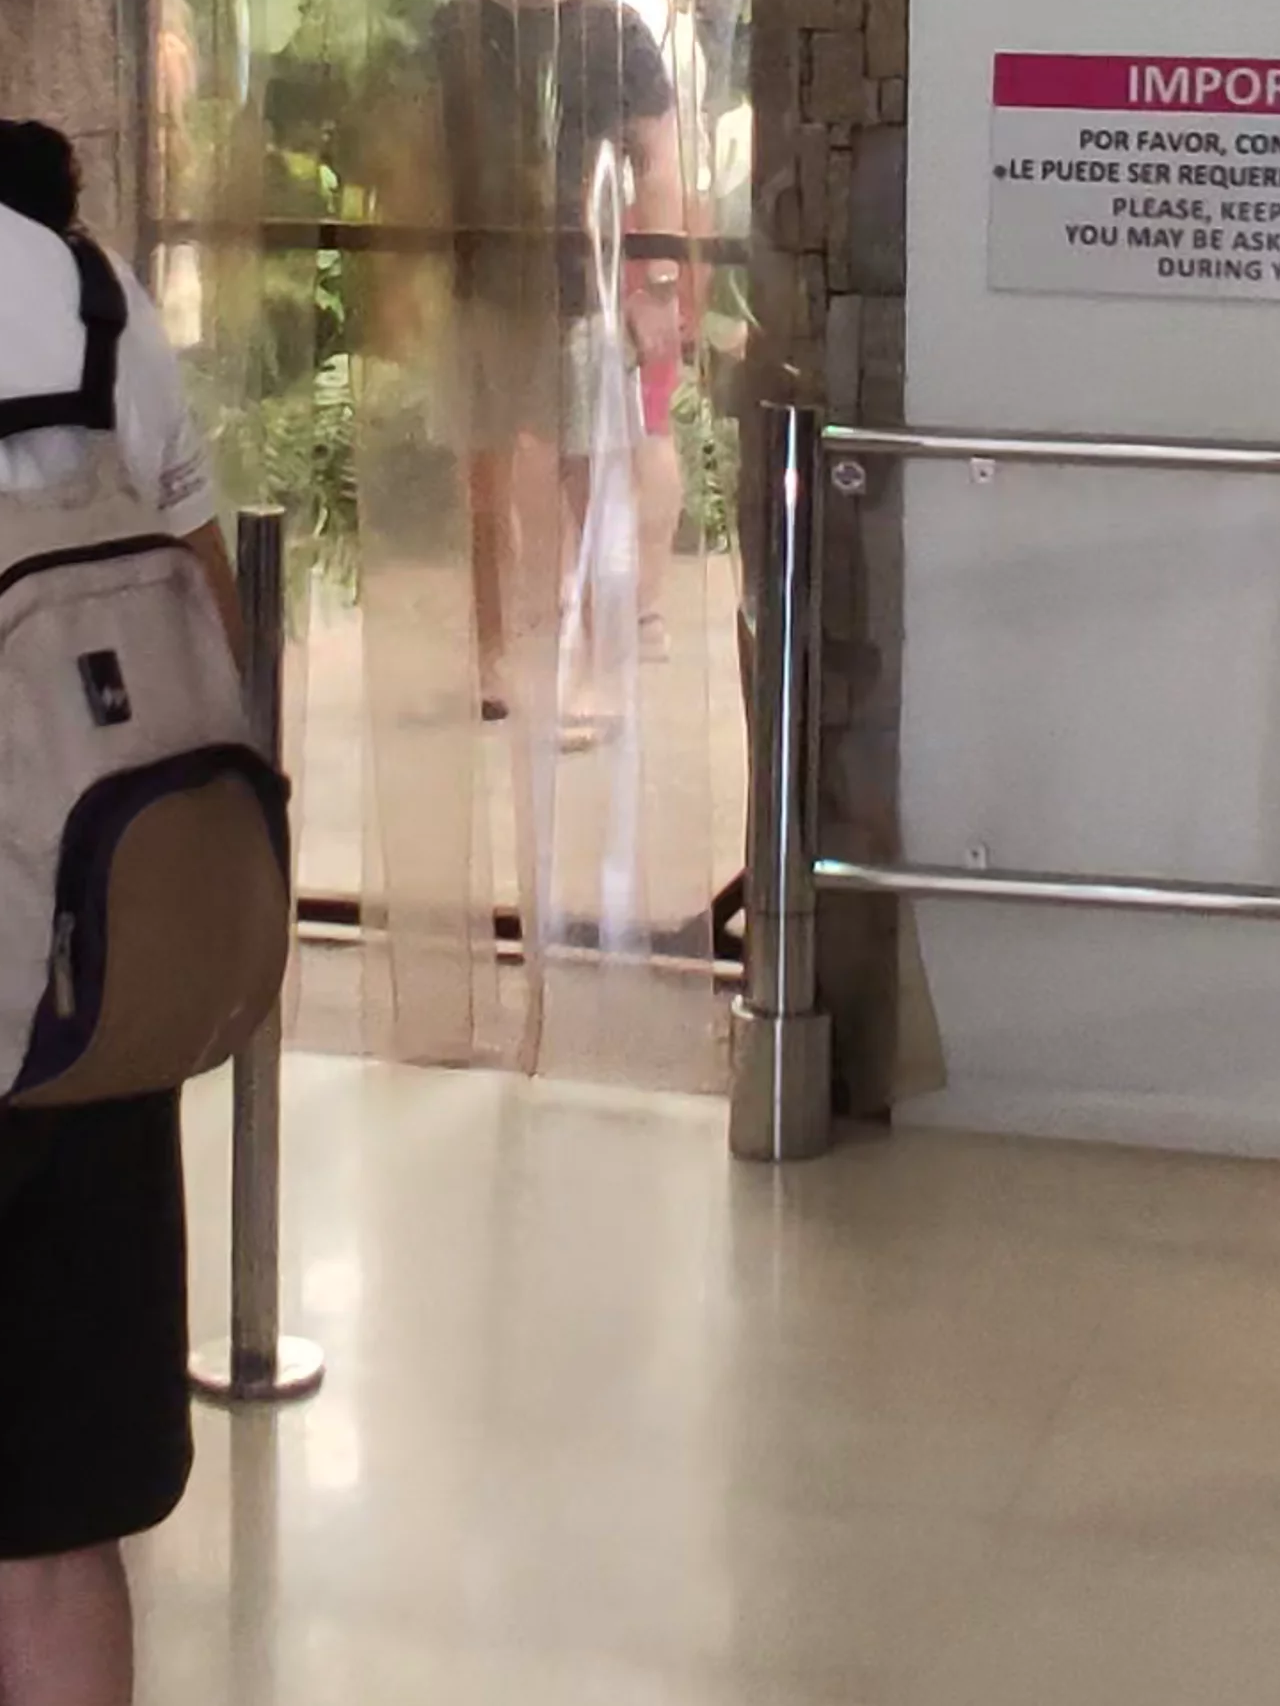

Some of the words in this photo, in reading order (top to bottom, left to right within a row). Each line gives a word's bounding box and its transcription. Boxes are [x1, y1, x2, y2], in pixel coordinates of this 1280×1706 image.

[1079, 129, 1130, 152] POR
[1136, 130, 1228, 157] FAVOR,
[1008, 158, 1035, 181] LE
[1041, 159, 1121, 184] PUEDE
[1127, 162, 1171, 185] SER
[1112, 197, 1213, 225] PLEASE,
[1065, 225, 1119, 247] YOU
[1126, 227, 1185, 249] MAY
[1192, 229, 1224, 251] BE
[1157, 256, 1263, 282] DURING
